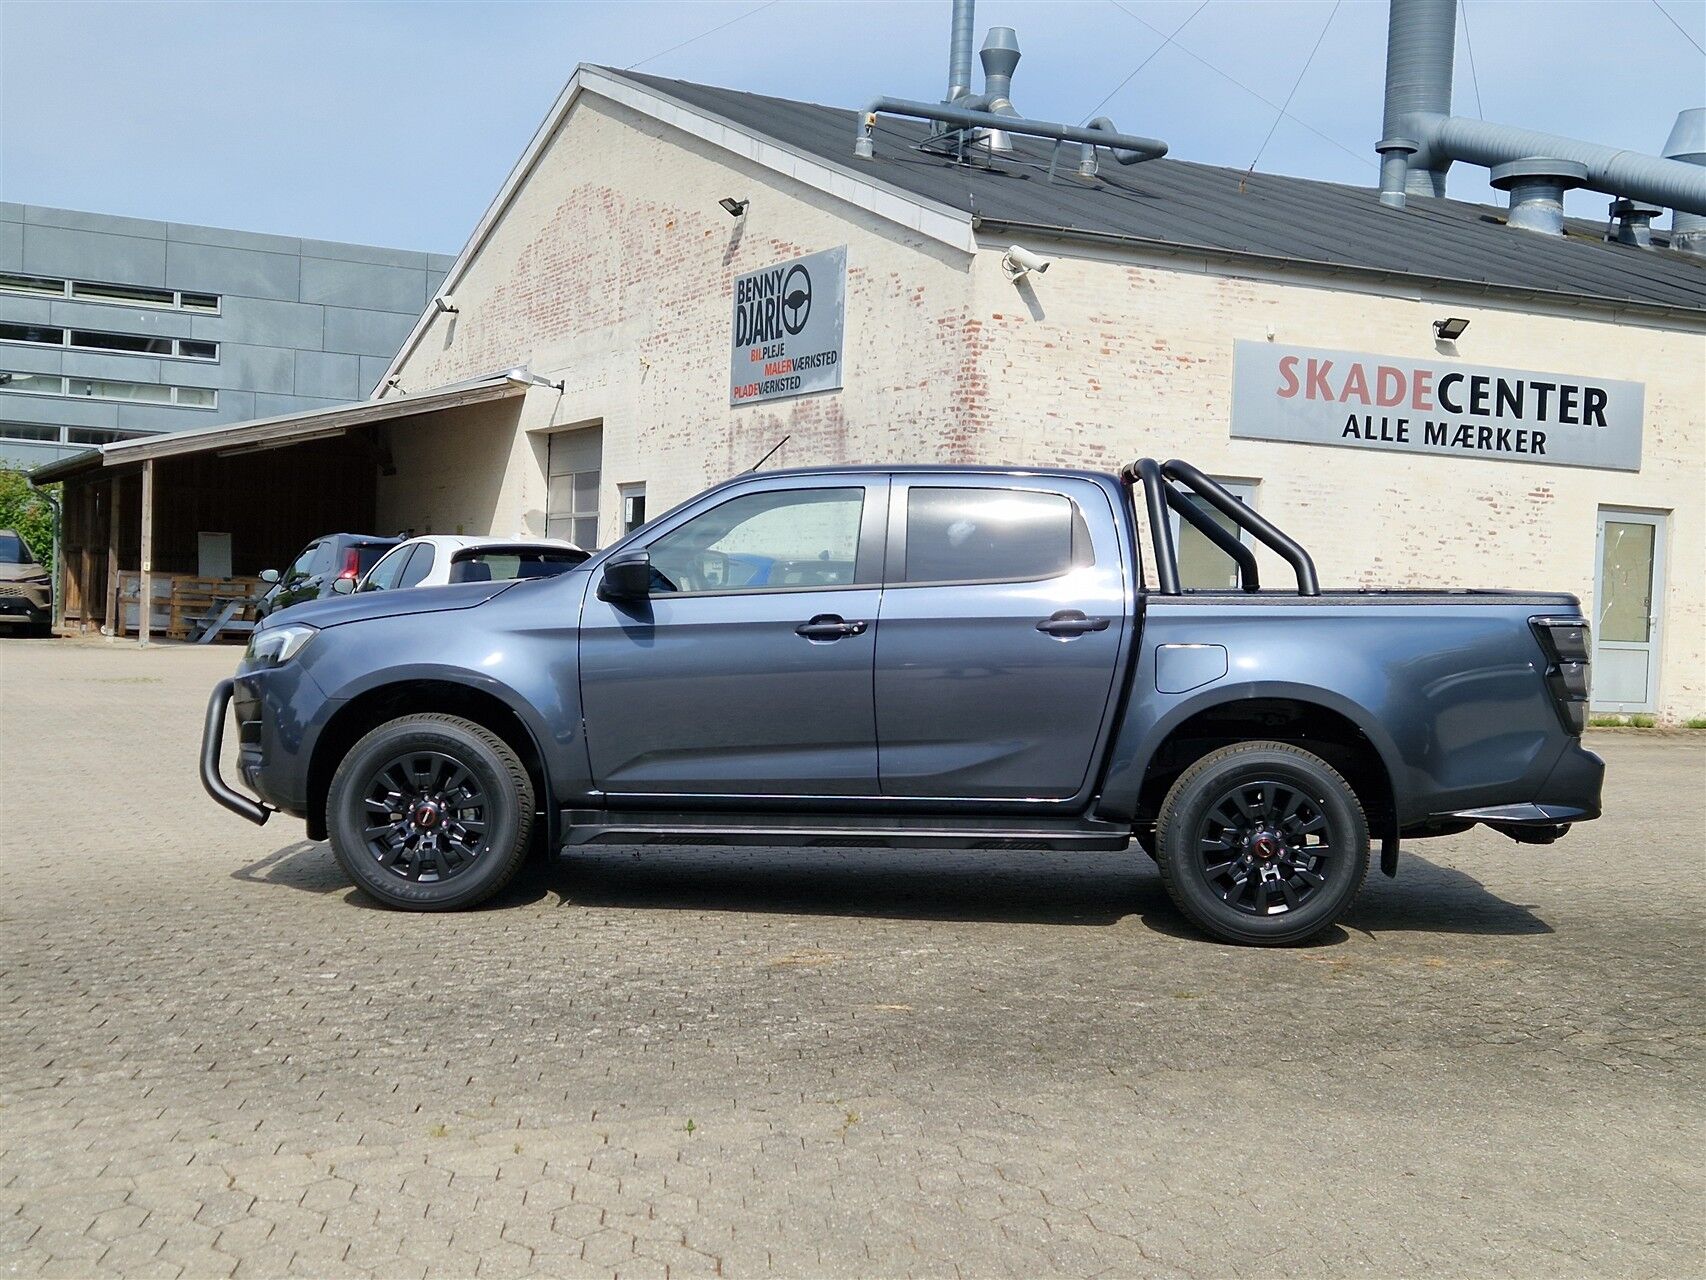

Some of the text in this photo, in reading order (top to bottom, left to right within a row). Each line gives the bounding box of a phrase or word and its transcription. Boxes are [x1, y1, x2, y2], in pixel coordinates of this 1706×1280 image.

[738, 268, 785, 304] BENNY
[751, 343, 785, 363] BILPLEJE
[764, 350, 837, 377] MALERVÆRKSTED
[734, 376, 801, 399] PLADEVÆRKSTED
[1276, 355, 1609, 428] SKADECENTER
[1342, 414, 1547, 455] ALLE MÆRKER
